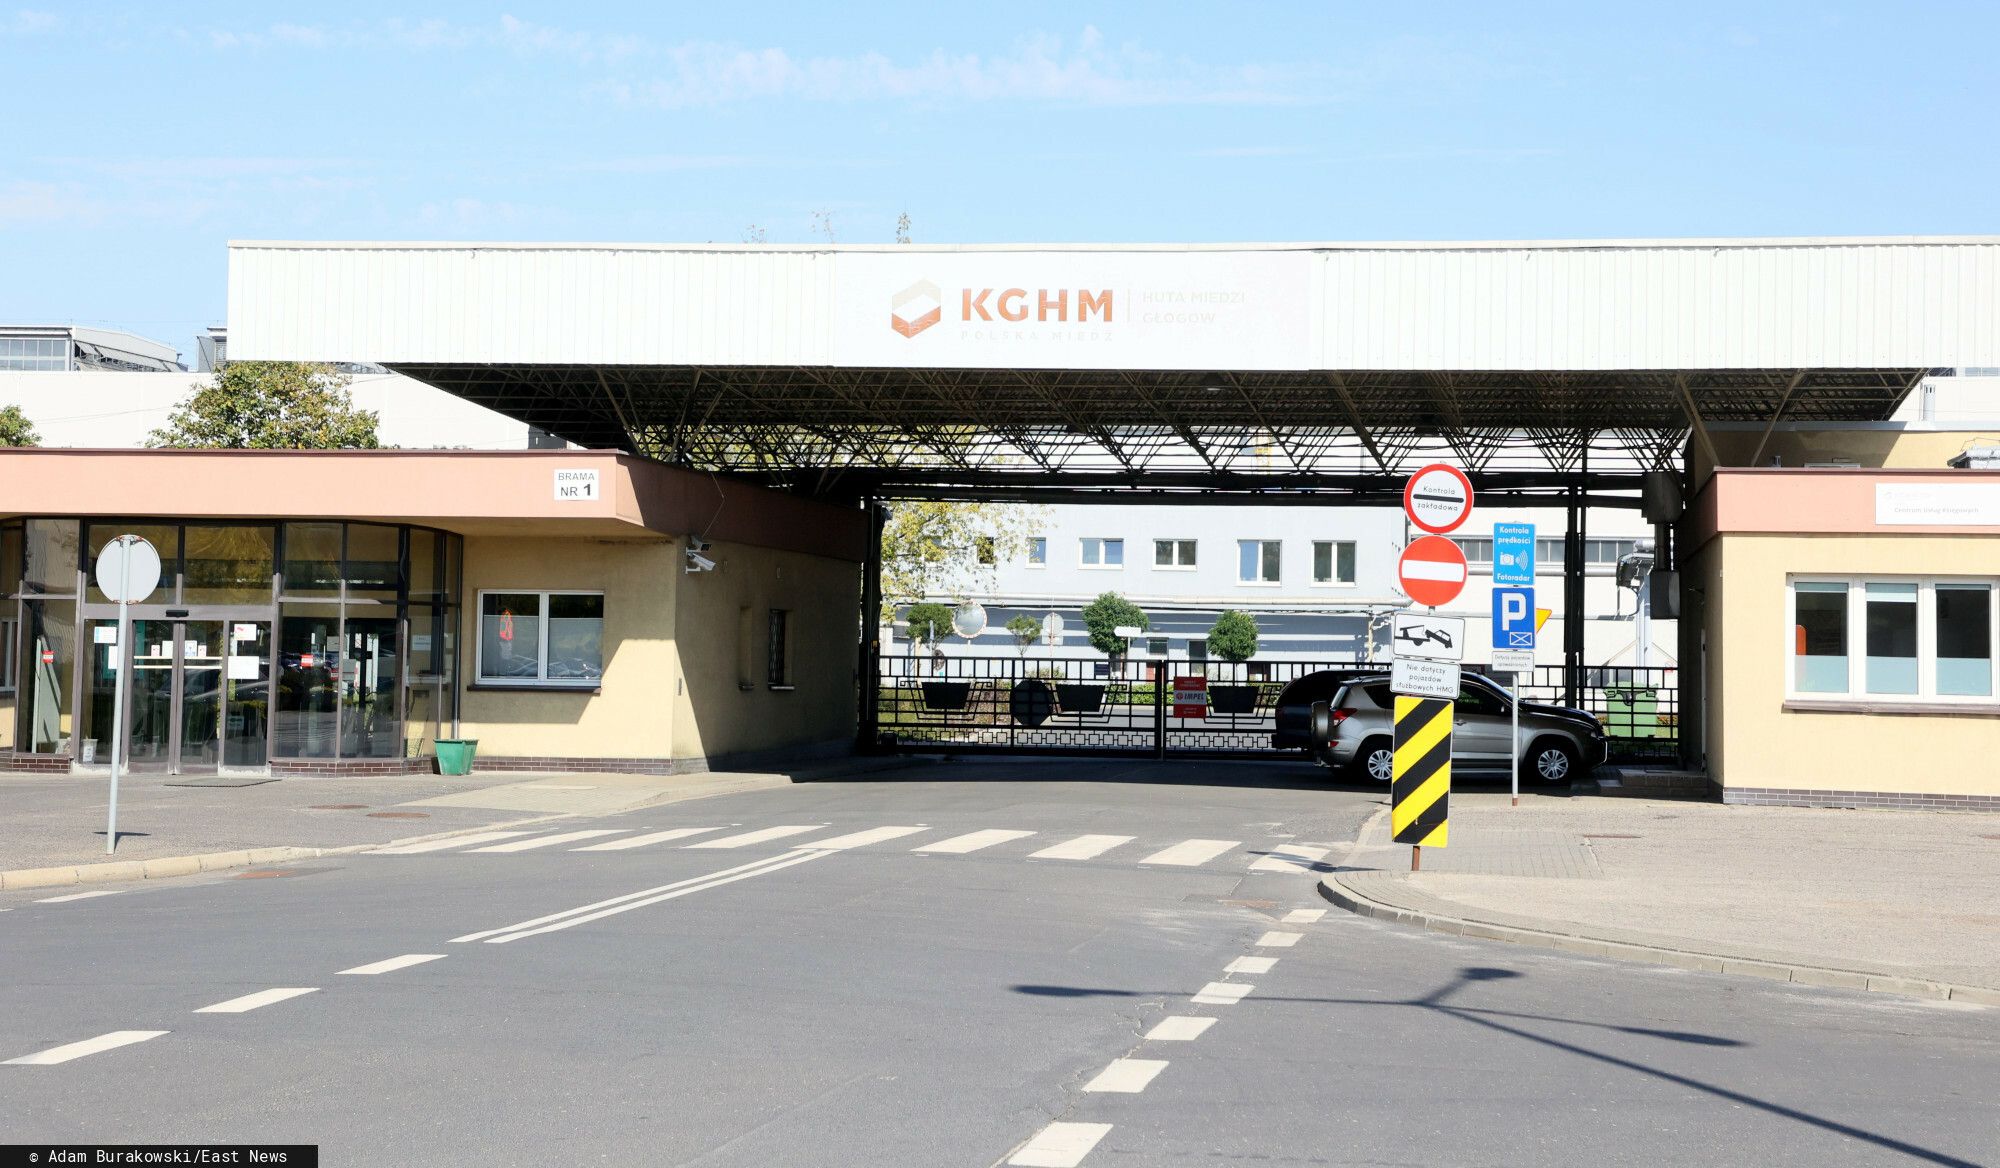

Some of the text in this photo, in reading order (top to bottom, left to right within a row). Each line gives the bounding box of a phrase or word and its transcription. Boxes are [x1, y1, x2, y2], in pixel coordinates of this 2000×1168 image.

[1143, 291, 1245, 304] HUTA MIEDZI
[961, 287, 1113, 322] KGHM
[961, 331, 1038, 342] POLSKA
[558, 472, 595, 481] BRAMA
[560, 483, 591, 497] NR 1
[1423, 485, 1456, 495] Kontrola
[1417, 502, 1458, 512] zakładowa
[1499, 525, 1530, 535] Kontrola
[1497, 572, 1531, 582] Fotoradar
[1501, 592, 1527, 631] P
[1406, 663, 1446, 675] Nie dotyczy
[1436, 685, 1454, 694] HMG
